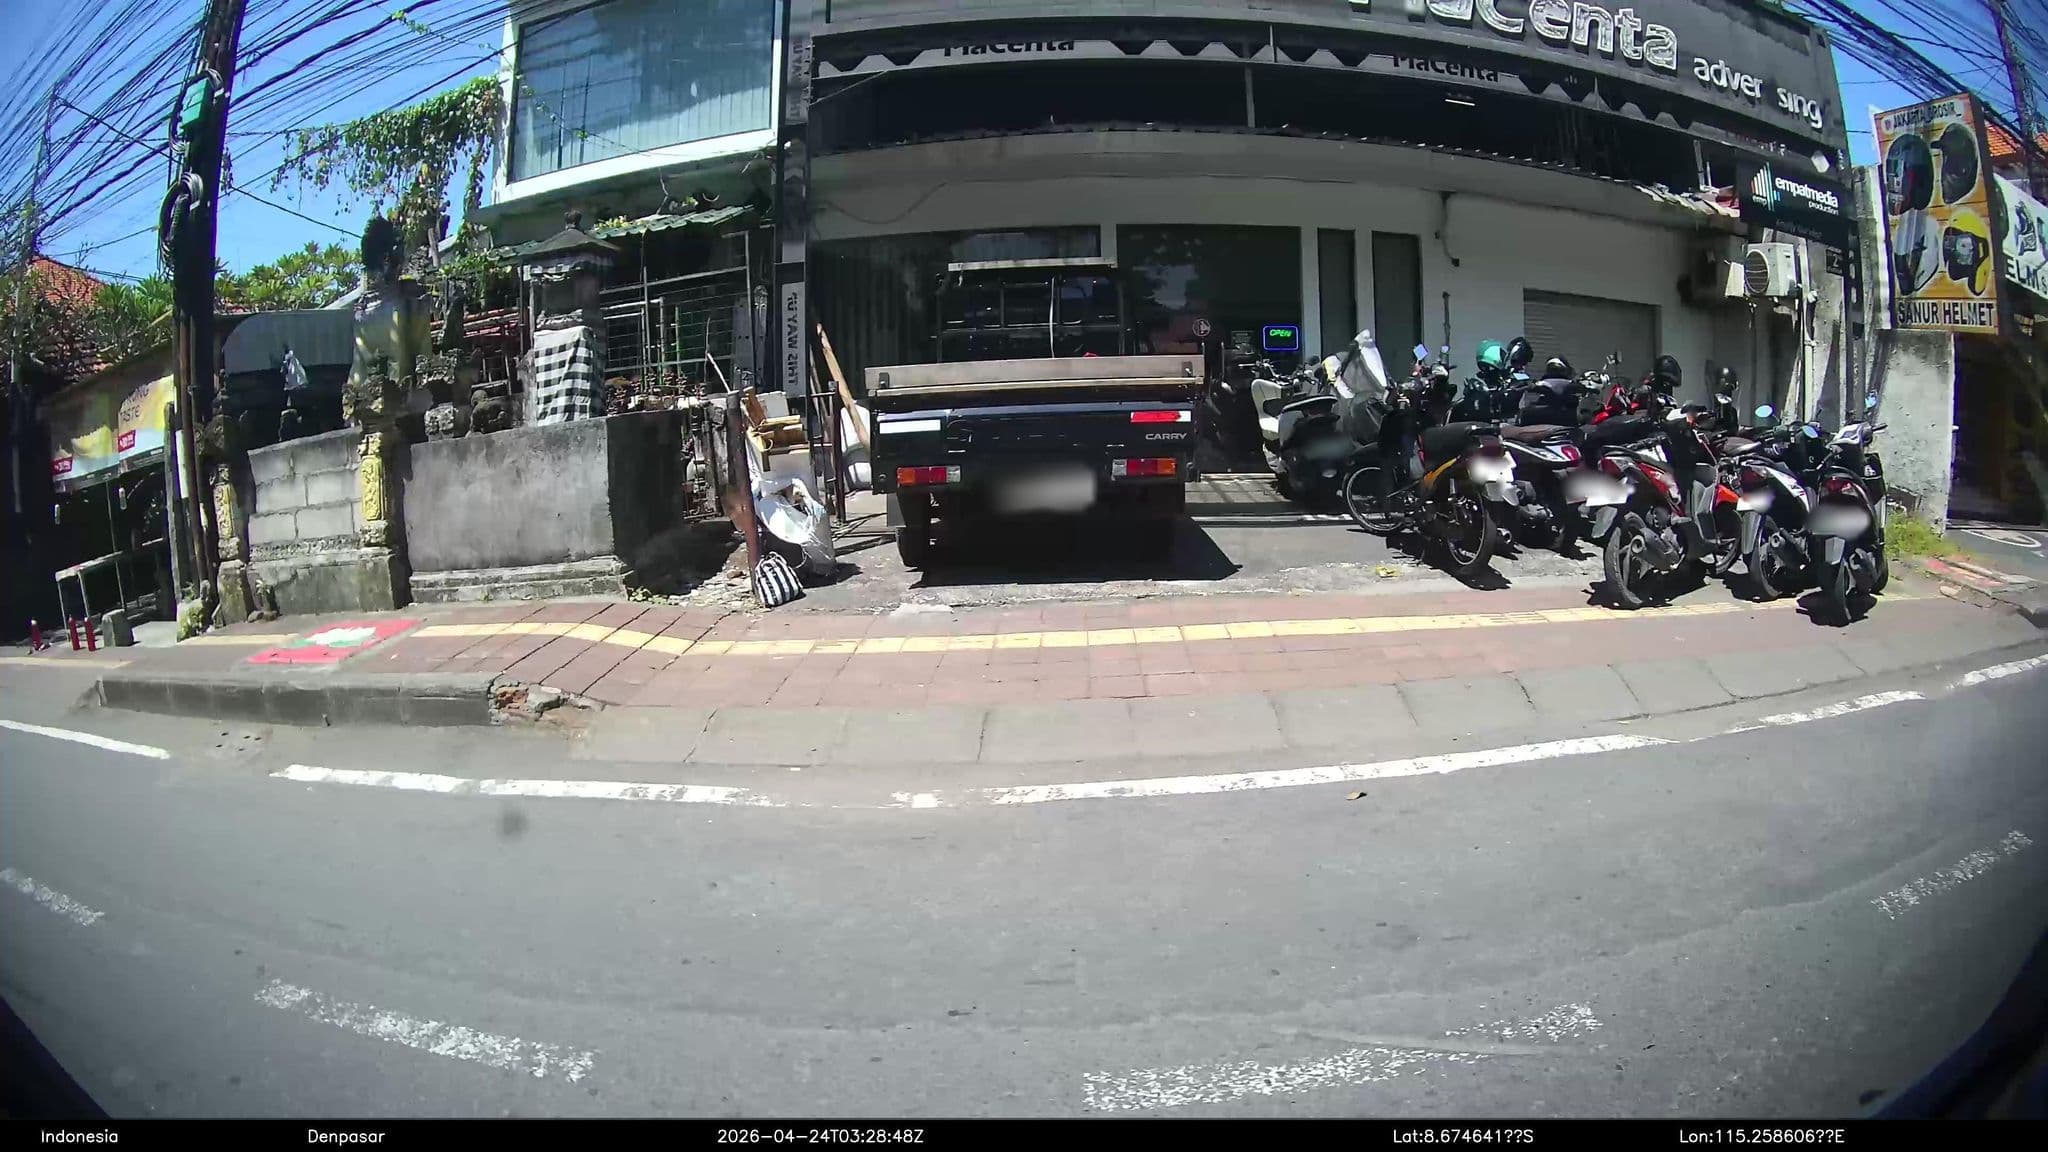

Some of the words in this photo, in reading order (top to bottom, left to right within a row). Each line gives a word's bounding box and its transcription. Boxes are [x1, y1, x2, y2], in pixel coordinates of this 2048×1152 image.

[1349, 0, 1677, 70] aCenta
[1693, 57, 1763, 98] adver
[1777, 87, 1823, 128] sing
[1774, 177, 1839, 208] empatmedia
[1897, 302, 1939, 325] SANUR
[1943, 302, 1995, 327] HELMET
[1269, 328, 1293, 338] OPEN
[1145, 432, 1188, 442] CARRY
